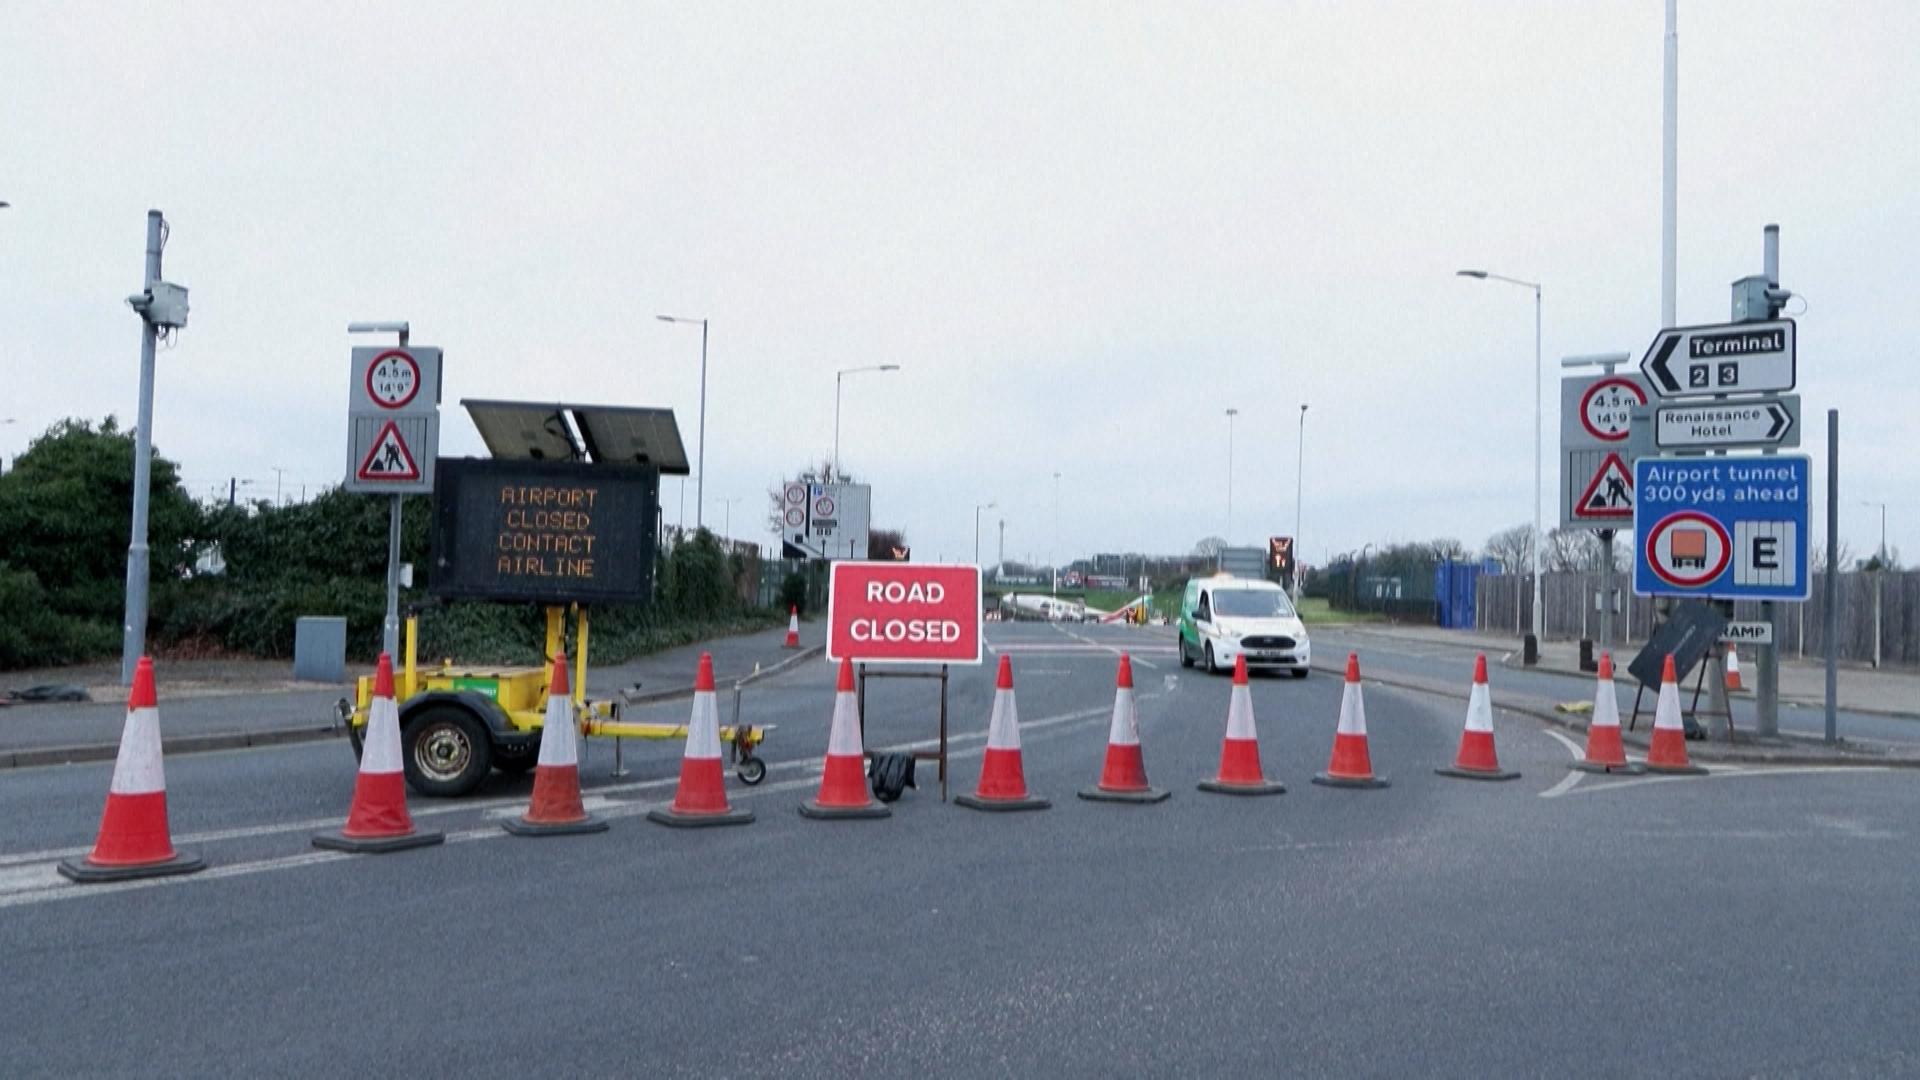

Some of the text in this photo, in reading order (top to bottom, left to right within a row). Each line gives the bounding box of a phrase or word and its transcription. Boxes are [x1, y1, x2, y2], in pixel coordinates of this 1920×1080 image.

[1692, 332, 1781, 355] Terminal
[1693, 365, 1735, 385] 2 3
[1665, 409, 1761, 423] Renaissance
[1691, 423, 1732, 437] Hotel
[1647, 464, 1798, 484] Airport tunnel
[501, 487, 598, 508] AIRPORT
[1644, 485, 1799, 504] 300 yds ahead
[507, 510, 590, 530] CLOSED
[499, 532, 596, 553] CONTACT
[1752, 537, 1779, 569] E
[498, 556, 595, 577] AIRLINE
[866, 580, 945, 604] ROAD
[850, 618, 961, 643] CLOSED
